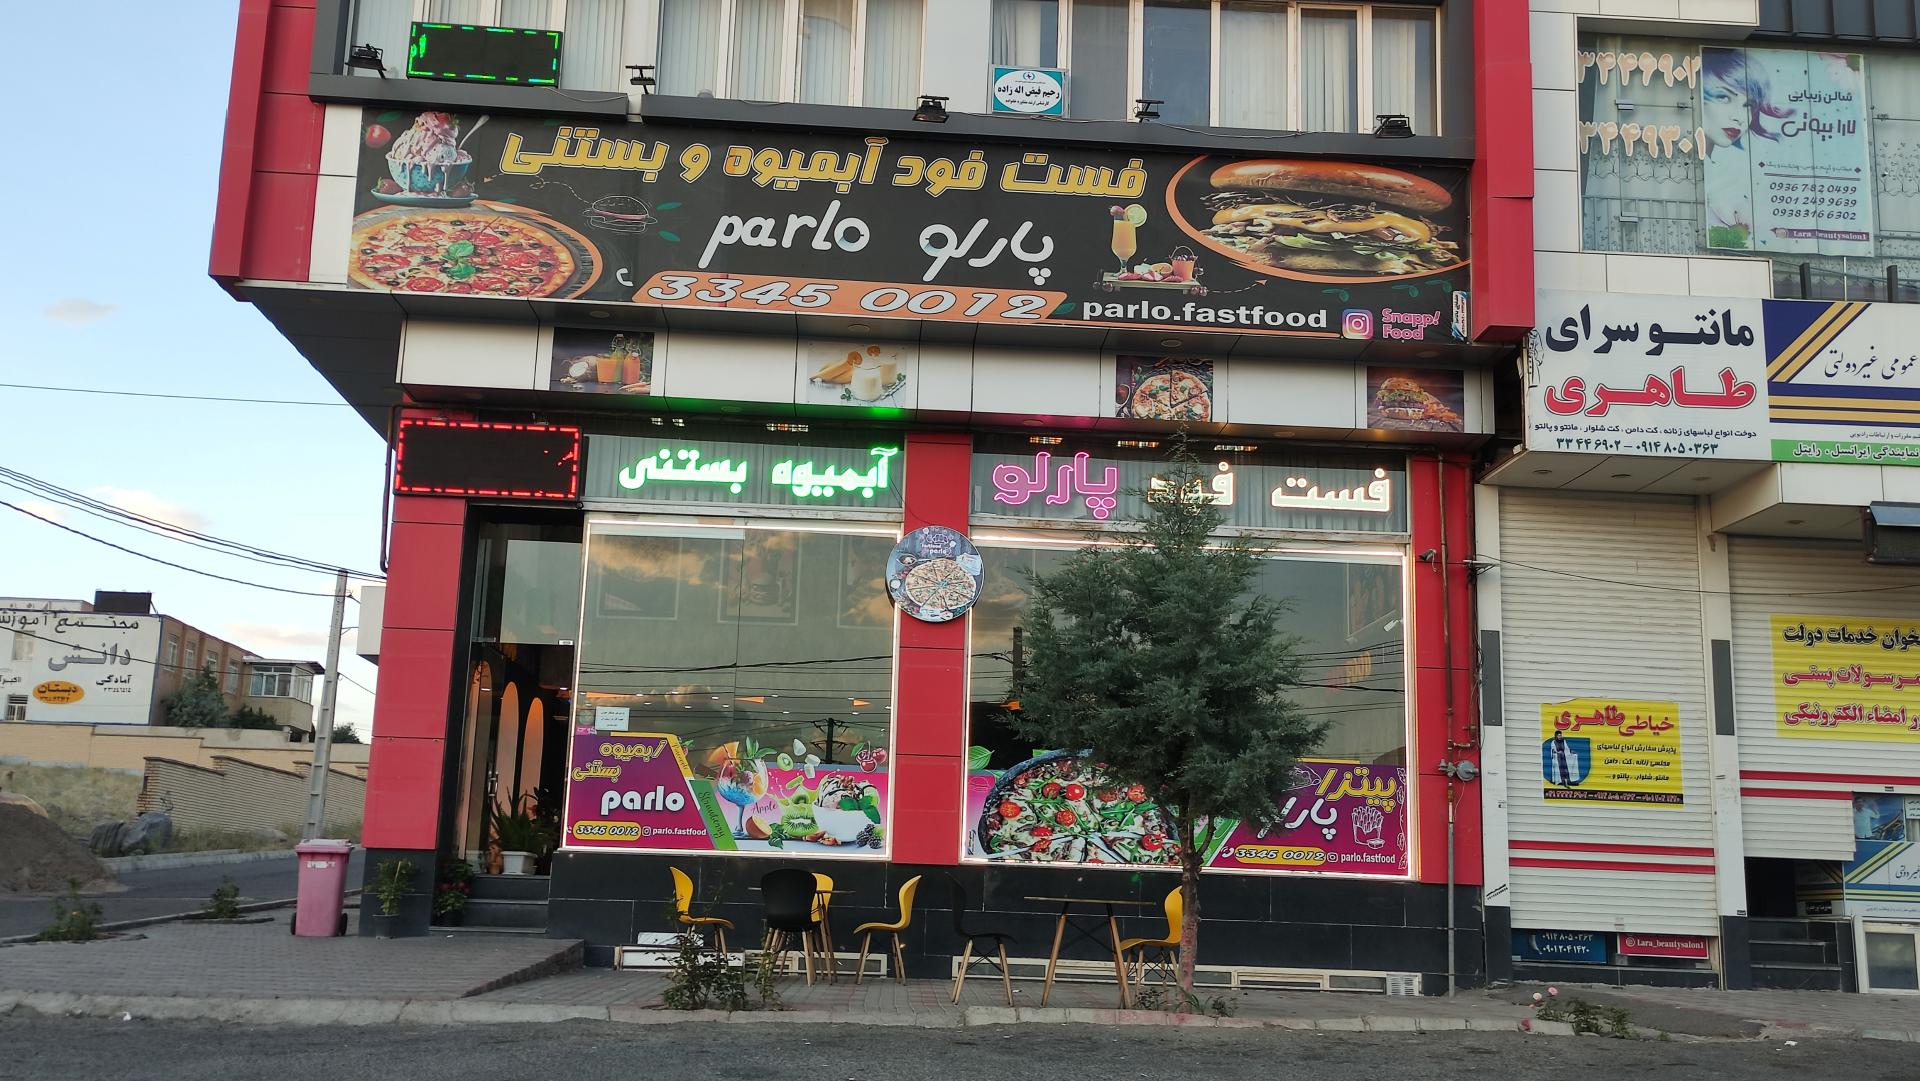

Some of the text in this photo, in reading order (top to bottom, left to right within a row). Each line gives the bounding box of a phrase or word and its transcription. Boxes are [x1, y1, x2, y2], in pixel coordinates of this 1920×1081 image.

[998, 84, 1012, 95] زاده
[1043, 89, 1060, 98] رحیم
[1788, 90, 1822, 102] زیبایی
[1781, 112, 1856, 142] لارا بیوتی
[499, 126, 1147, 199] فست فود آبمیوه و بستنی
[1770, 182, 1856, 194] 0936 782 0499
[1770, 195, 1856, 208] 0901 249 9639
[699, 200, 870, 269] parlo
[919, 218, 1054, 286] پارلو
[647, 275, 1046, 320] 3345 0012
[1082, 299, 1327, 329] parlo.fastfood
[1382, 308, 1440, 327] Snapp!
[1382, 324, 1424, 340] Food
[1546, 304, 1754, 356] مانتو سرای
[1882, 354, 1919, 380] عمومی
[1545, 365, 1757, 417] طاهری
[1535, 423, 1552, 432] پالتو
[1625, 426, 1644, 434] دامن
[1684, 428, 1712, 437] لباسهای
[1715, 430, 1732, 439] انواع
[1734, 430, 1756, 438] دوخت
[1688, 444, 1718, 454] ۰۳۶۳
[1794, 444, 1919, 460] نمایندگی ایرانسل رایتل
[618, 447, 898, 498] آبمیوه بستنی
[992, 451, 1118, 519] پارلو
[1271, 468, 1390, 512] فست
[55, 616, 139, 634] مجتمع
[1784, 624, 1824, 647] دولت
[1827, 626, 1878, 644] خدمات
[48, 642, 130, 671] دانش
[96, 674, 132, 686] آمادگی
[1784, 665, 1834, 688] پستی
[38, 684, 78, 694] دبستان
[1554, 704, 1674, 736] خیاطی طاهری
[1784, 702, 1864, 727] الکترونیکی
[1867, 704, 1906, 724] امضاء
[572, 760, 621, 783] بستنی
[1315, 767, 1397, 812] پیتزا
[601, 786, 684, 816] parlo
[750, 800, 778, 814] Apple
[576, 825, 639, 836] 3345 0012
[652, 827, 707, 836] parlo.fastfood
[1236, 849, 1326, 861] 3345 0012
[1340, 853, 1396, 864] parlo.fastfood
